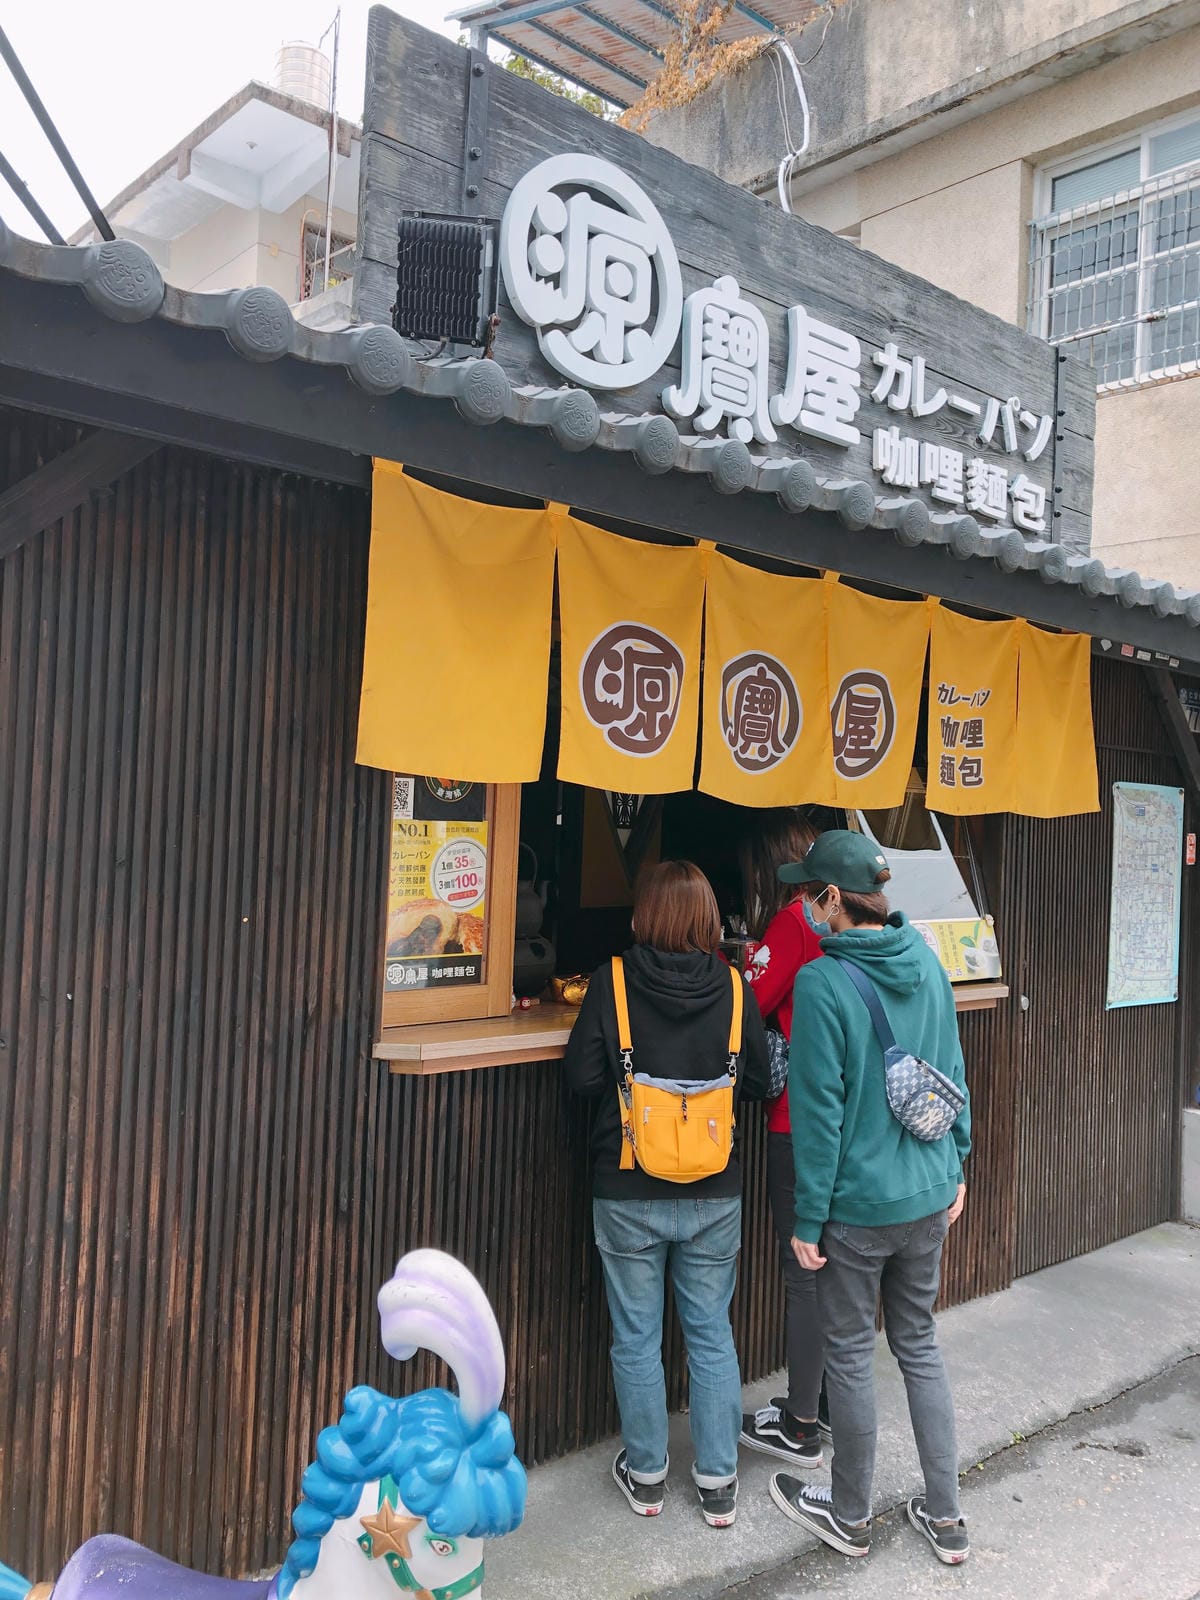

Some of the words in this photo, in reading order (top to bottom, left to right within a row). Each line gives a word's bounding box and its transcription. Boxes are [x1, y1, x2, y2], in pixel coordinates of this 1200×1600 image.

[871, 343, 1054, 462] カレーパン
[872, 425, 1047, 532] 咖哩麵包
[937, 683, 991, 707] カレーパン
[940, 716, 984, 748] 咖哩
[940, 754, 983, 787] 麵包
[397, 823, 429, 838] NO.1
[454, 855, 469, 869] 35
[456, 873, 478, 889] 100
[432, 966, 476, 979] 咖哩麵包
